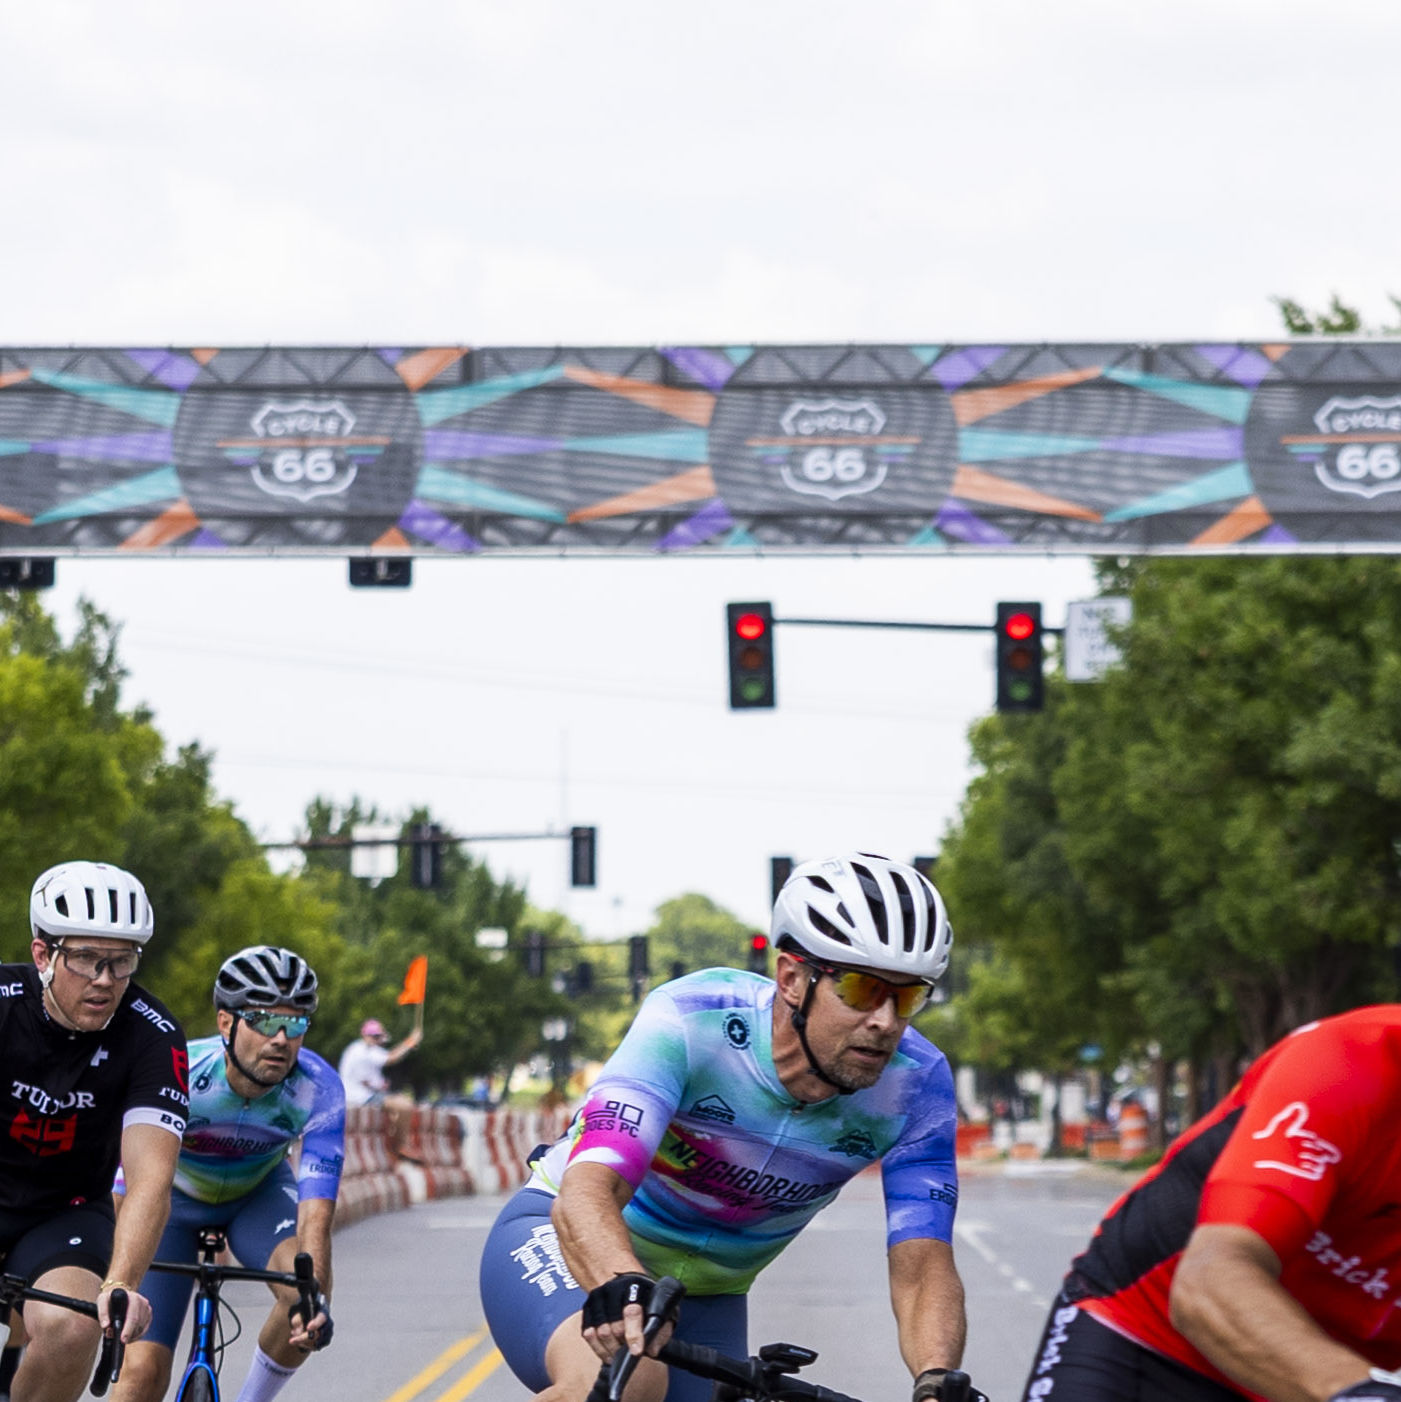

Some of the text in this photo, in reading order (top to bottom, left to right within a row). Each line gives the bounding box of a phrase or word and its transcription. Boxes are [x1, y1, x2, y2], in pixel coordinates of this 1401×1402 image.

[267, 413, 341, 436] CYCLE
[799, 414, 872, 435] CYCLE
[273, 448, 336, 482] 66
[803, 447, 866, 482] 66
[1336, 443, 1401, 480] 66
[130, 998, 176, 1033] BMC
[160, 1113, 186, 1132] BO
[618, 1121, 640, 1138] PC
